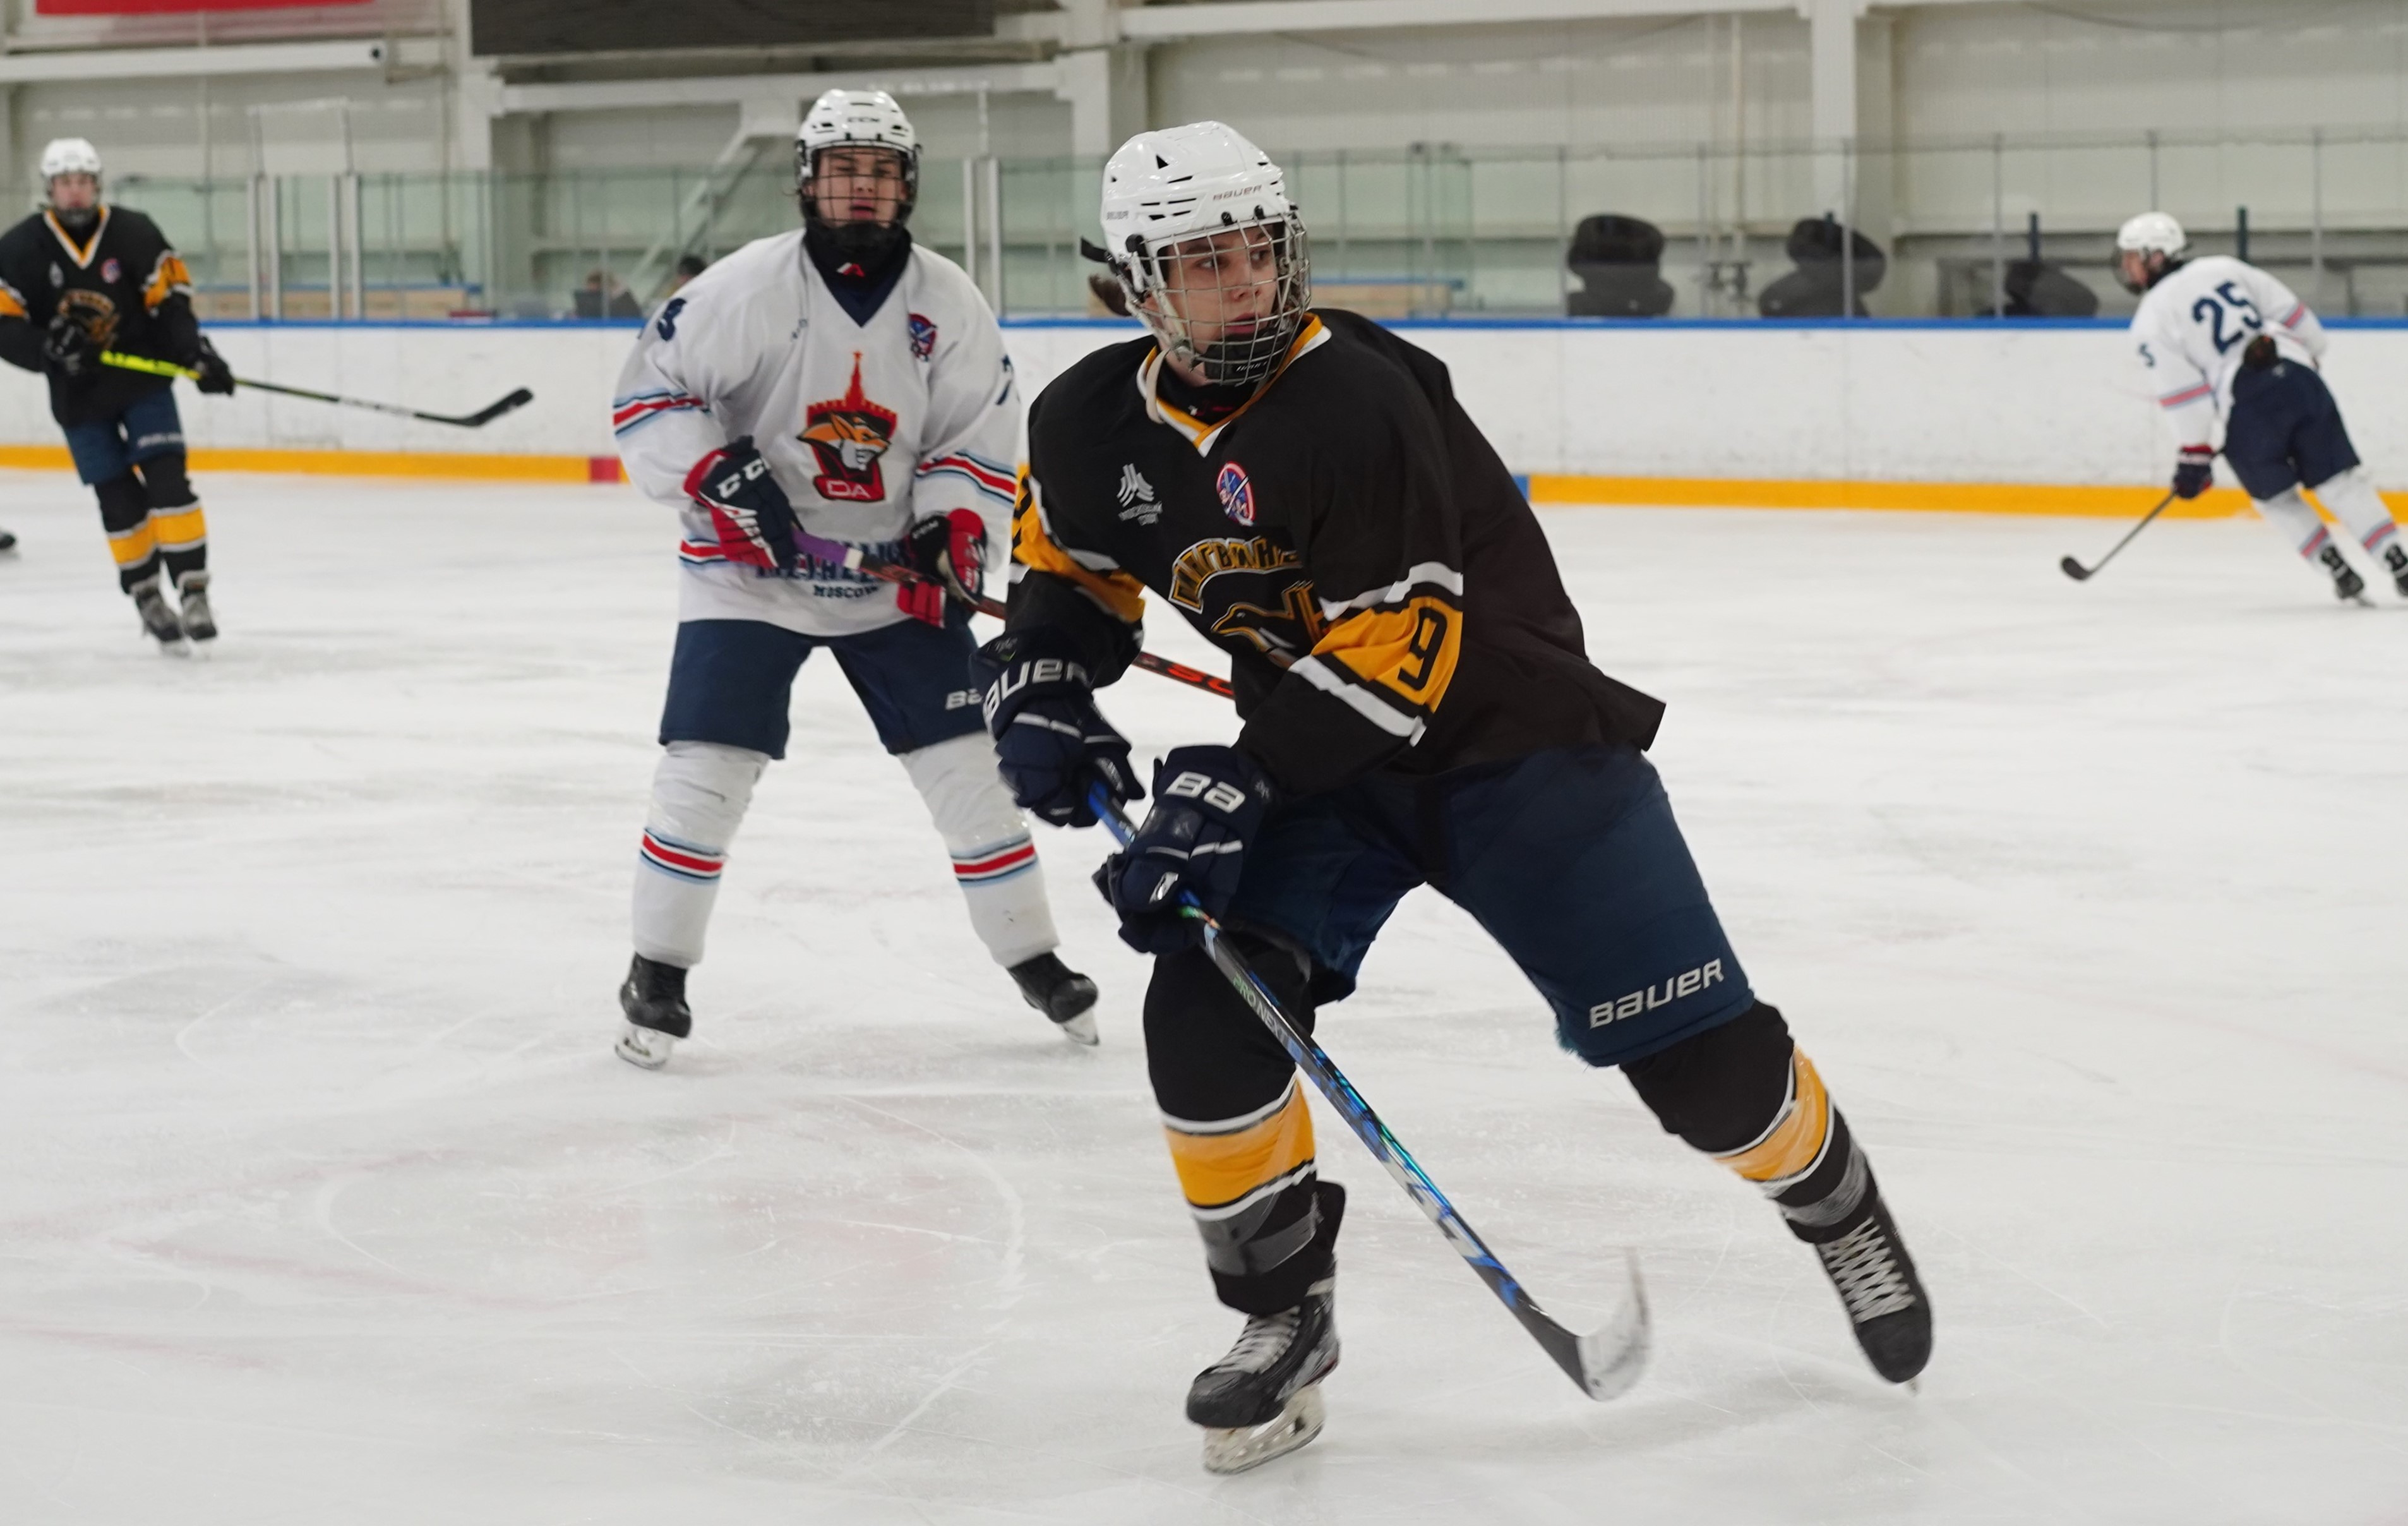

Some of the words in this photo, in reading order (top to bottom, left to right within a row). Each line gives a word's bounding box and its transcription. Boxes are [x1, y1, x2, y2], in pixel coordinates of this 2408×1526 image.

[1213, 185, 1262, 200] BAUER
[2193, 280, 2263, 356] 25
[716, 457, 772, 498] CC
[826, 480, 872, 499] DA
[1397, 607, 1448, 692] 9
[1589, 958, 1725, 1030] BAUER
